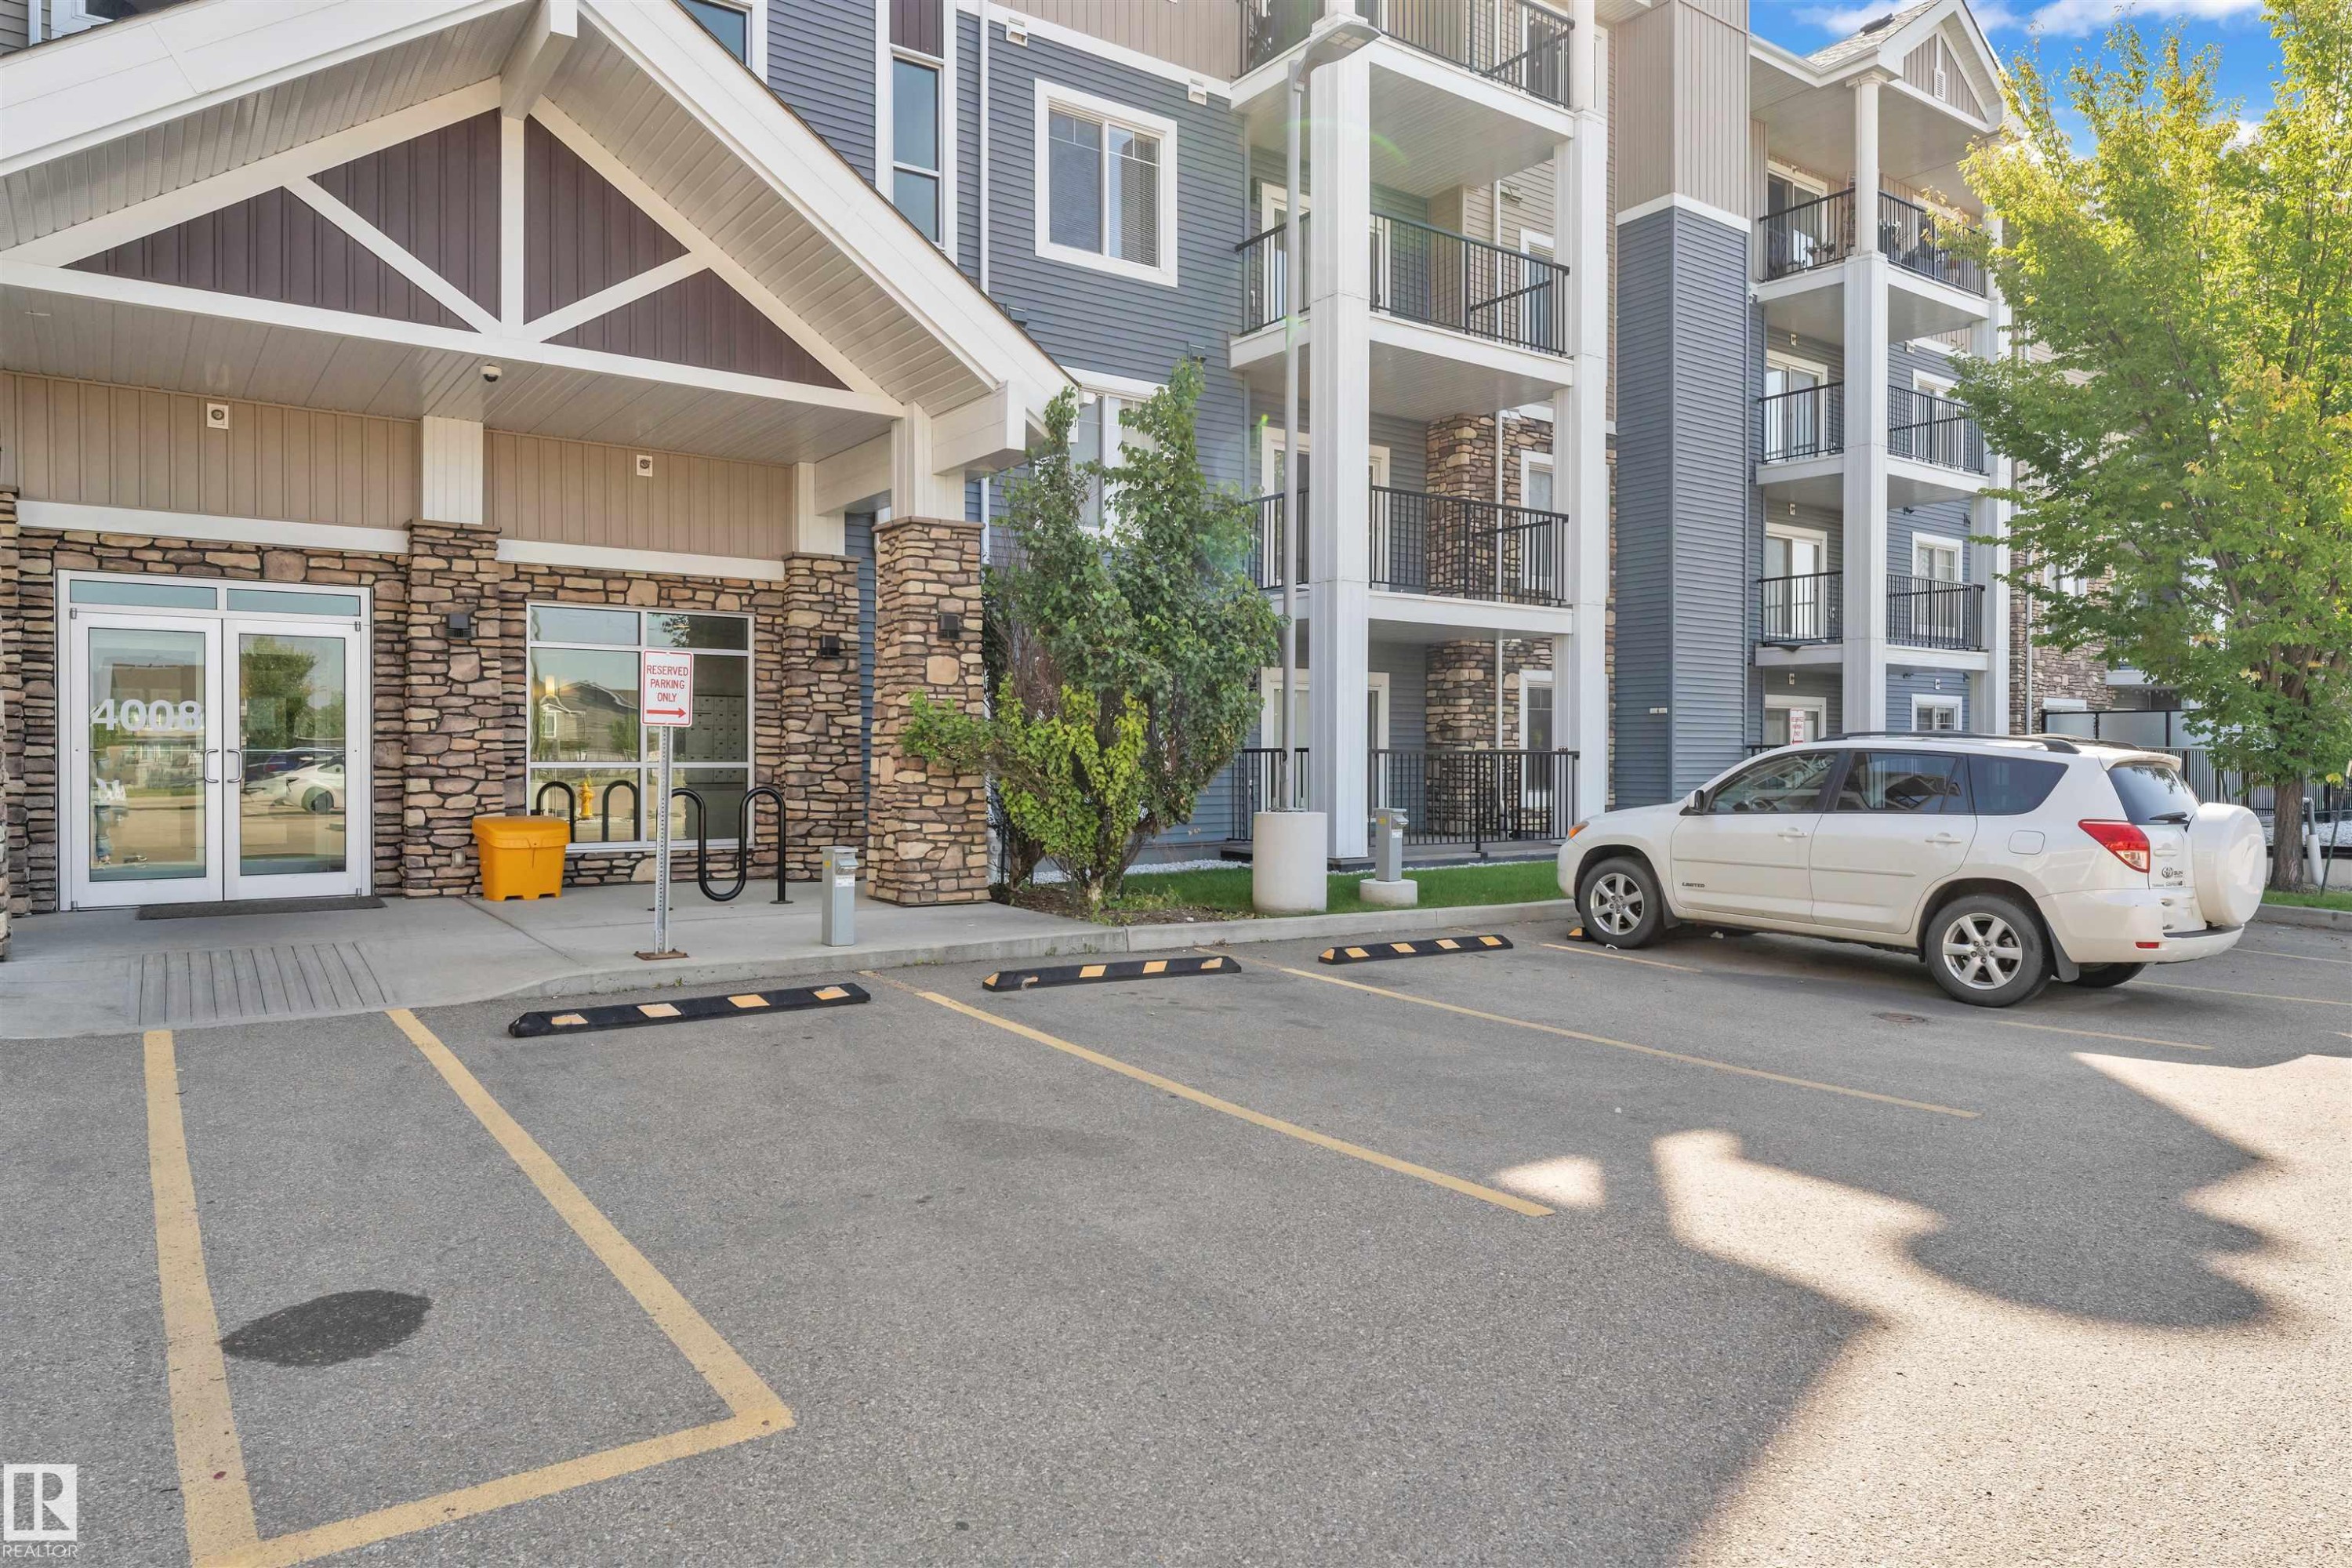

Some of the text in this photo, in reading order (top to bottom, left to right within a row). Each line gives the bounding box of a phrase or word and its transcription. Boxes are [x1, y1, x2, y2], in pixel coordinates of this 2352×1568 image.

[647, 665, 689, 677] RESERVED
[650, 679, 685, 689] PARKING
[657, 692, 677, 702] ONLY
[91, 699, 202, 732] 4008
